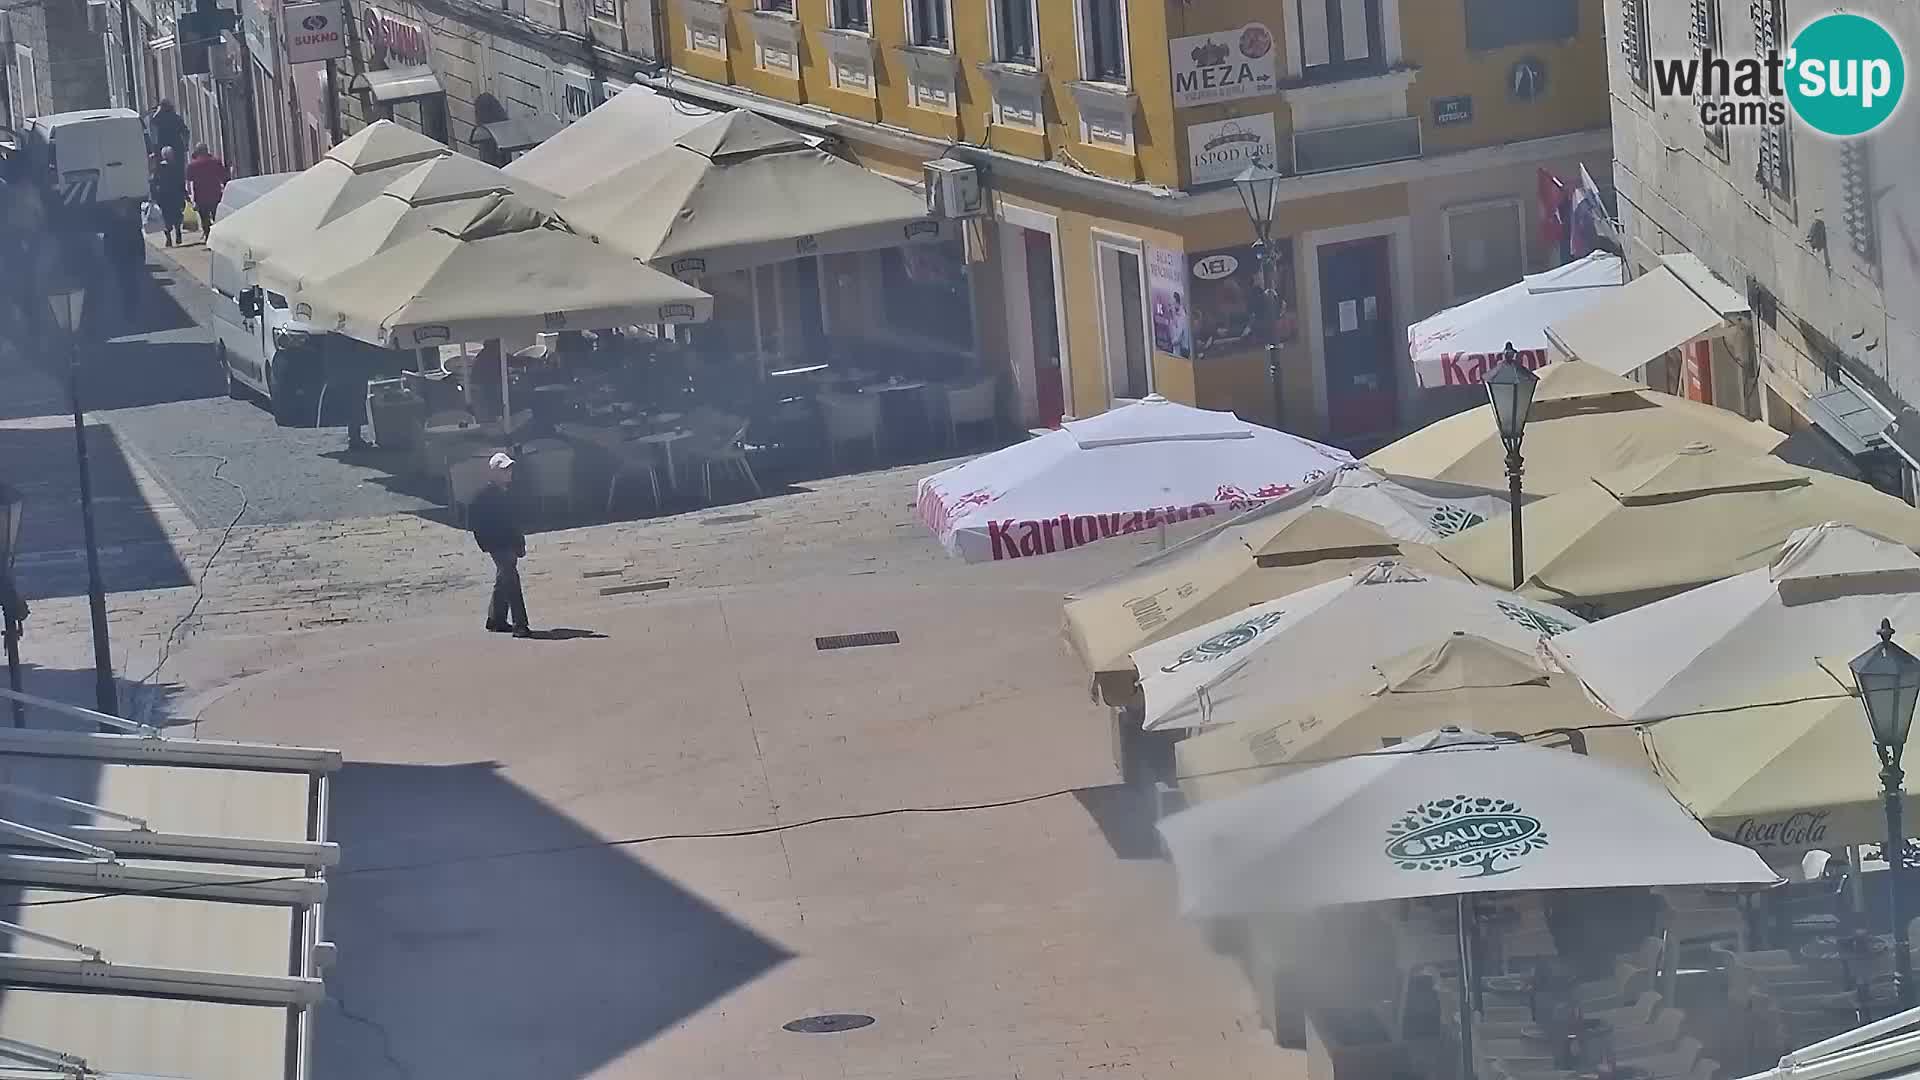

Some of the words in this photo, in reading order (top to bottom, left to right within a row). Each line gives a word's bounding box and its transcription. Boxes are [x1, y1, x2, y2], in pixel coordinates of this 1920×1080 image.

[295, 32, 338, 46] SUKNO
[1176, 63, 1255, 93] MEZA
[1194, 148, 1240, 167] ISPOD
[1424, 820, 1523, 850] RAUCH
